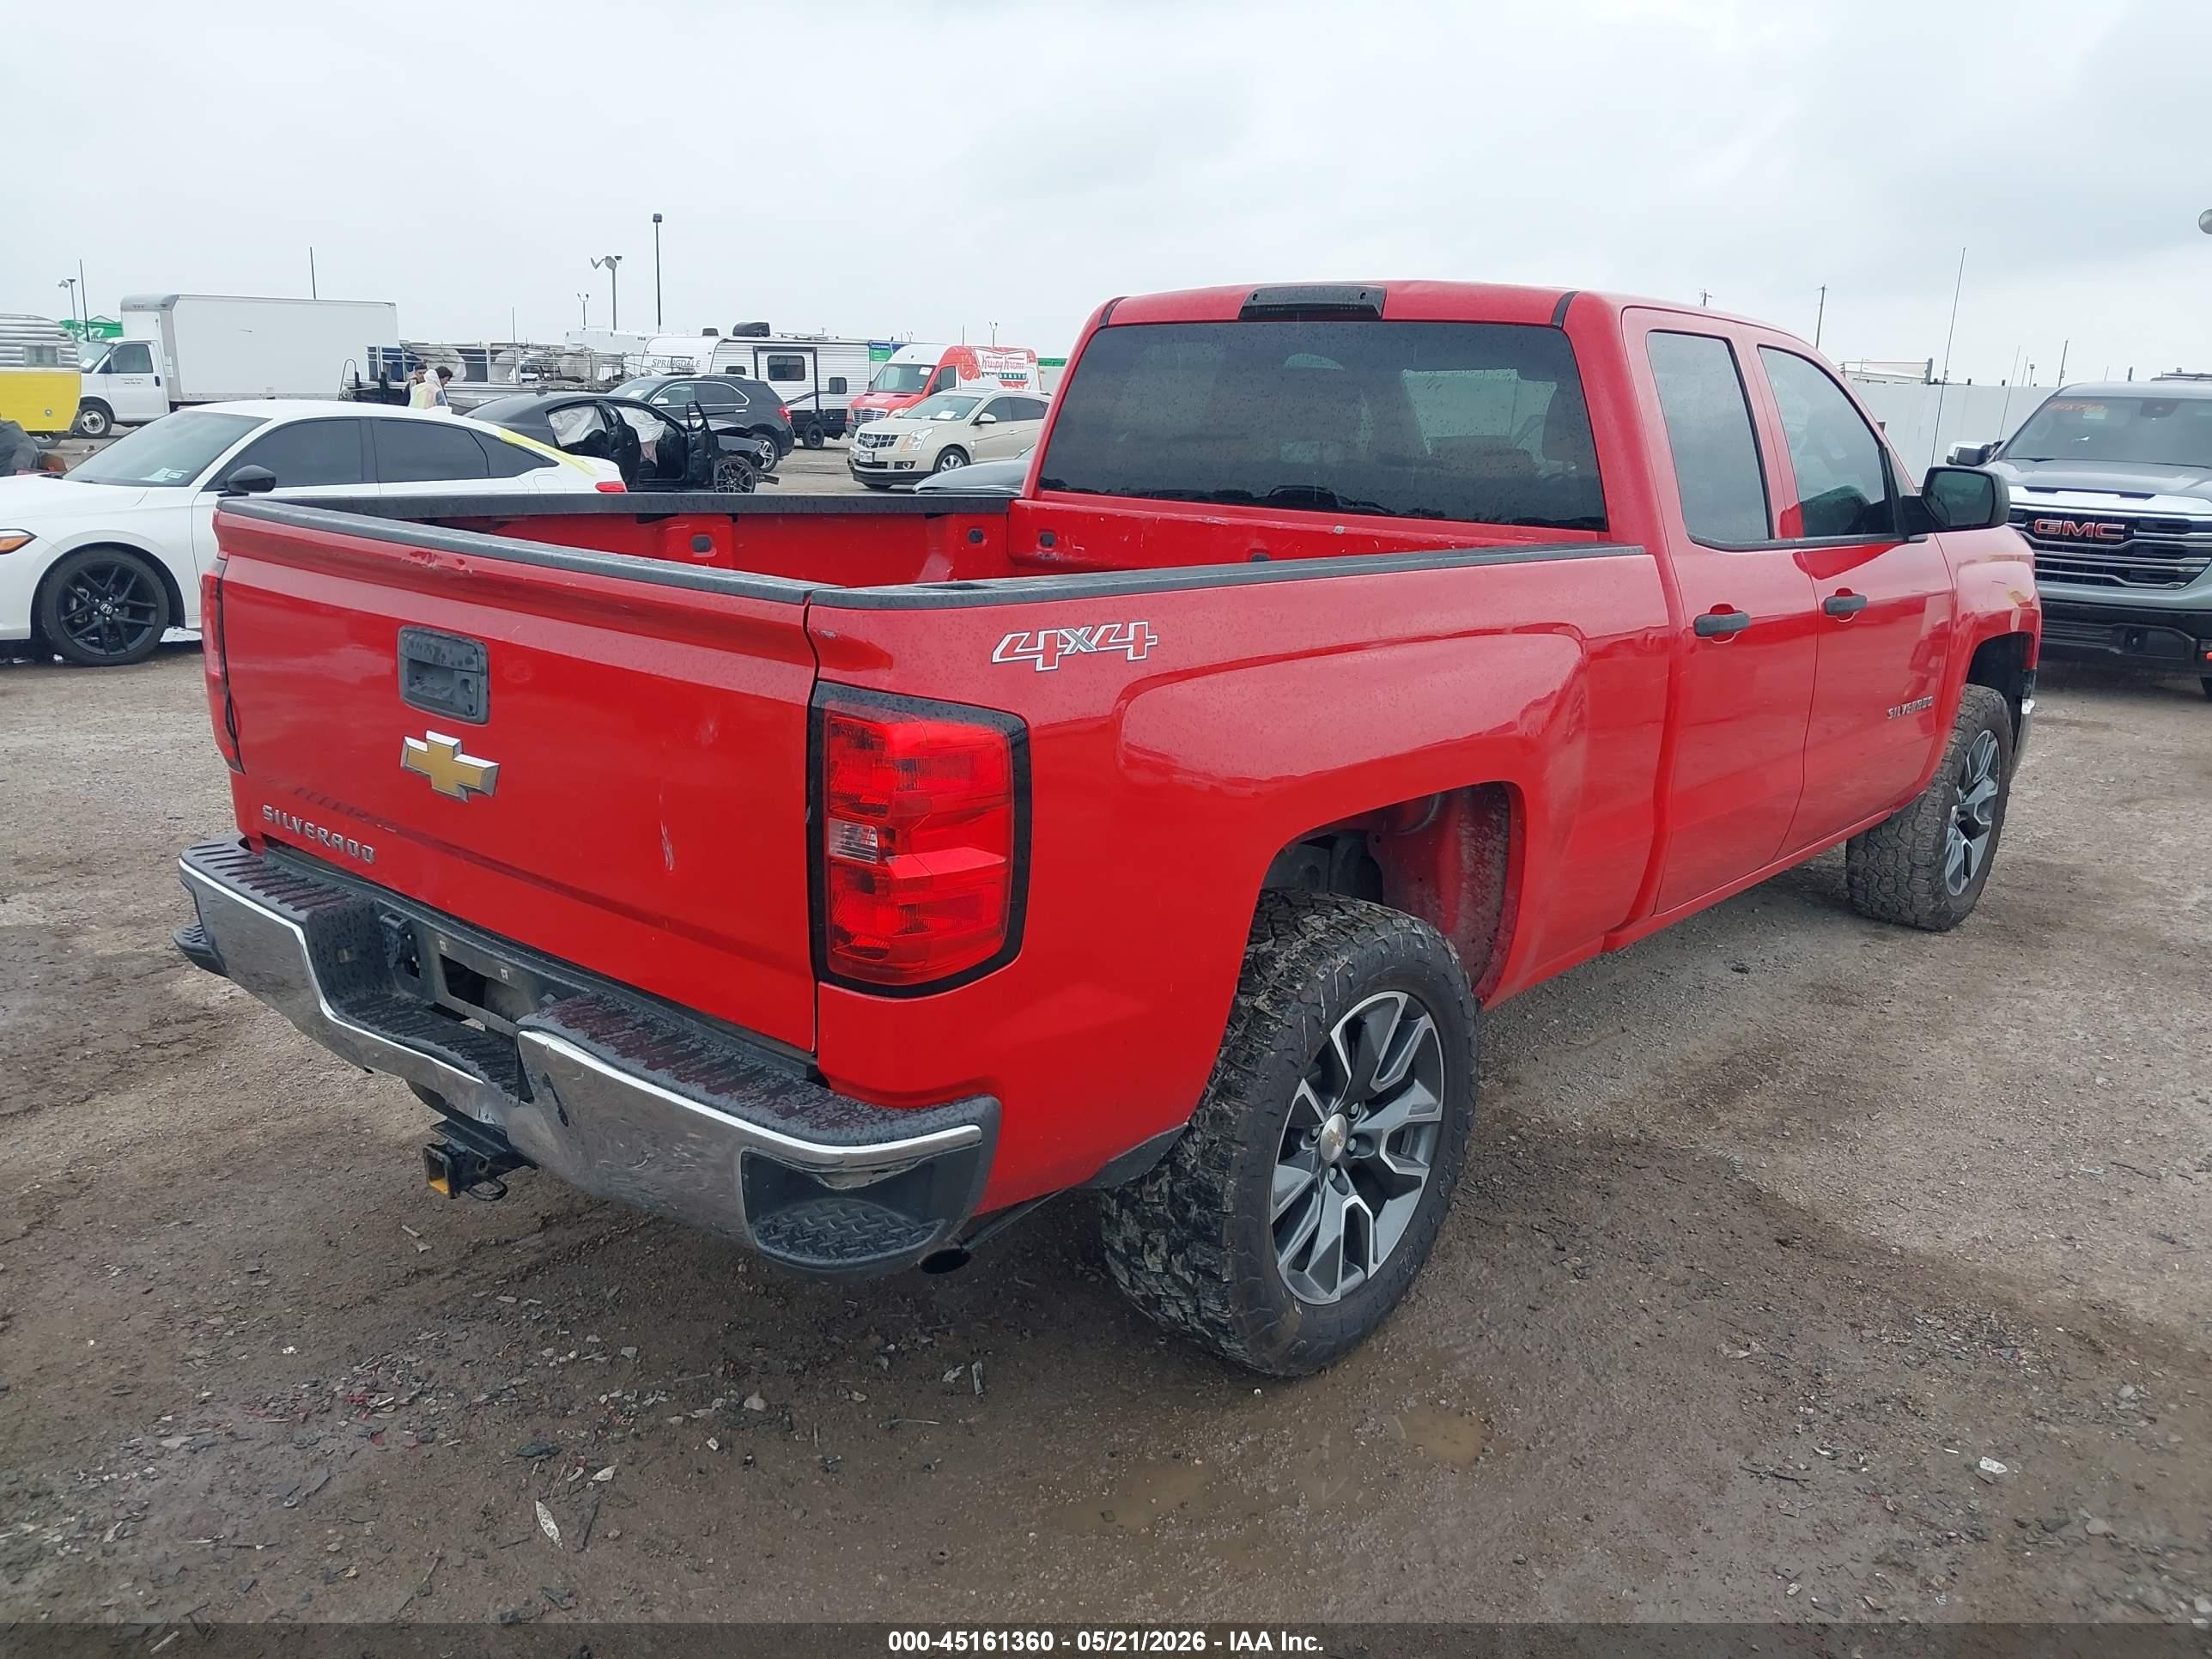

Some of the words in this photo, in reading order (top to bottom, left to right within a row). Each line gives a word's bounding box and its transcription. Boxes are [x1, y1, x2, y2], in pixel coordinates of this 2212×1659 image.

[652, 359, 701, 368] SPRINGDALE
[2034, 519, 2125, 539] GMC
[1887, 696, 1933, 720] SILVERADO
[262, 804, 376, 865] SILVERADO
